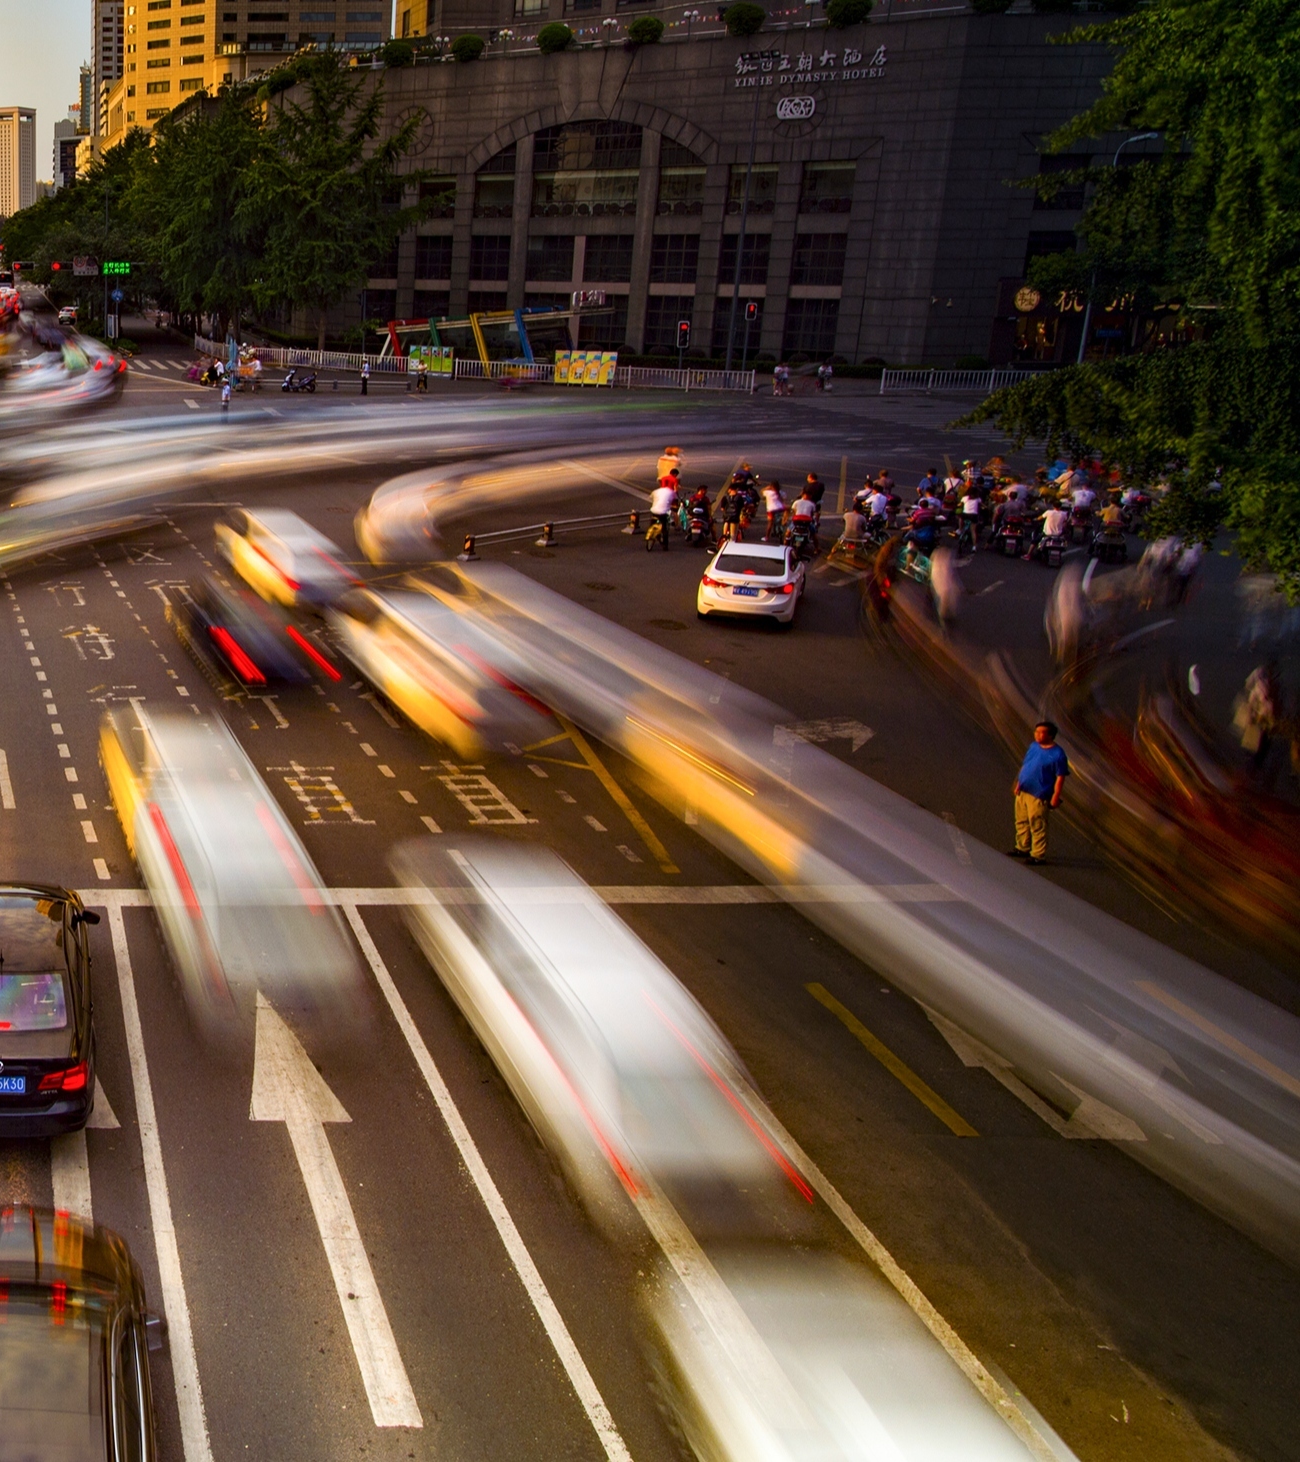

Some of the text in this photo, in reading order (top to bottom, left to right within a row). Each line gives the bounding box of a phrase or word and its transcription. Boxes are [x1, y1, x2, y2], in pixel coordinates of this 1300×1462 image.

[734, 68, 886, 88] YINHE DYNASTY HOTEL
